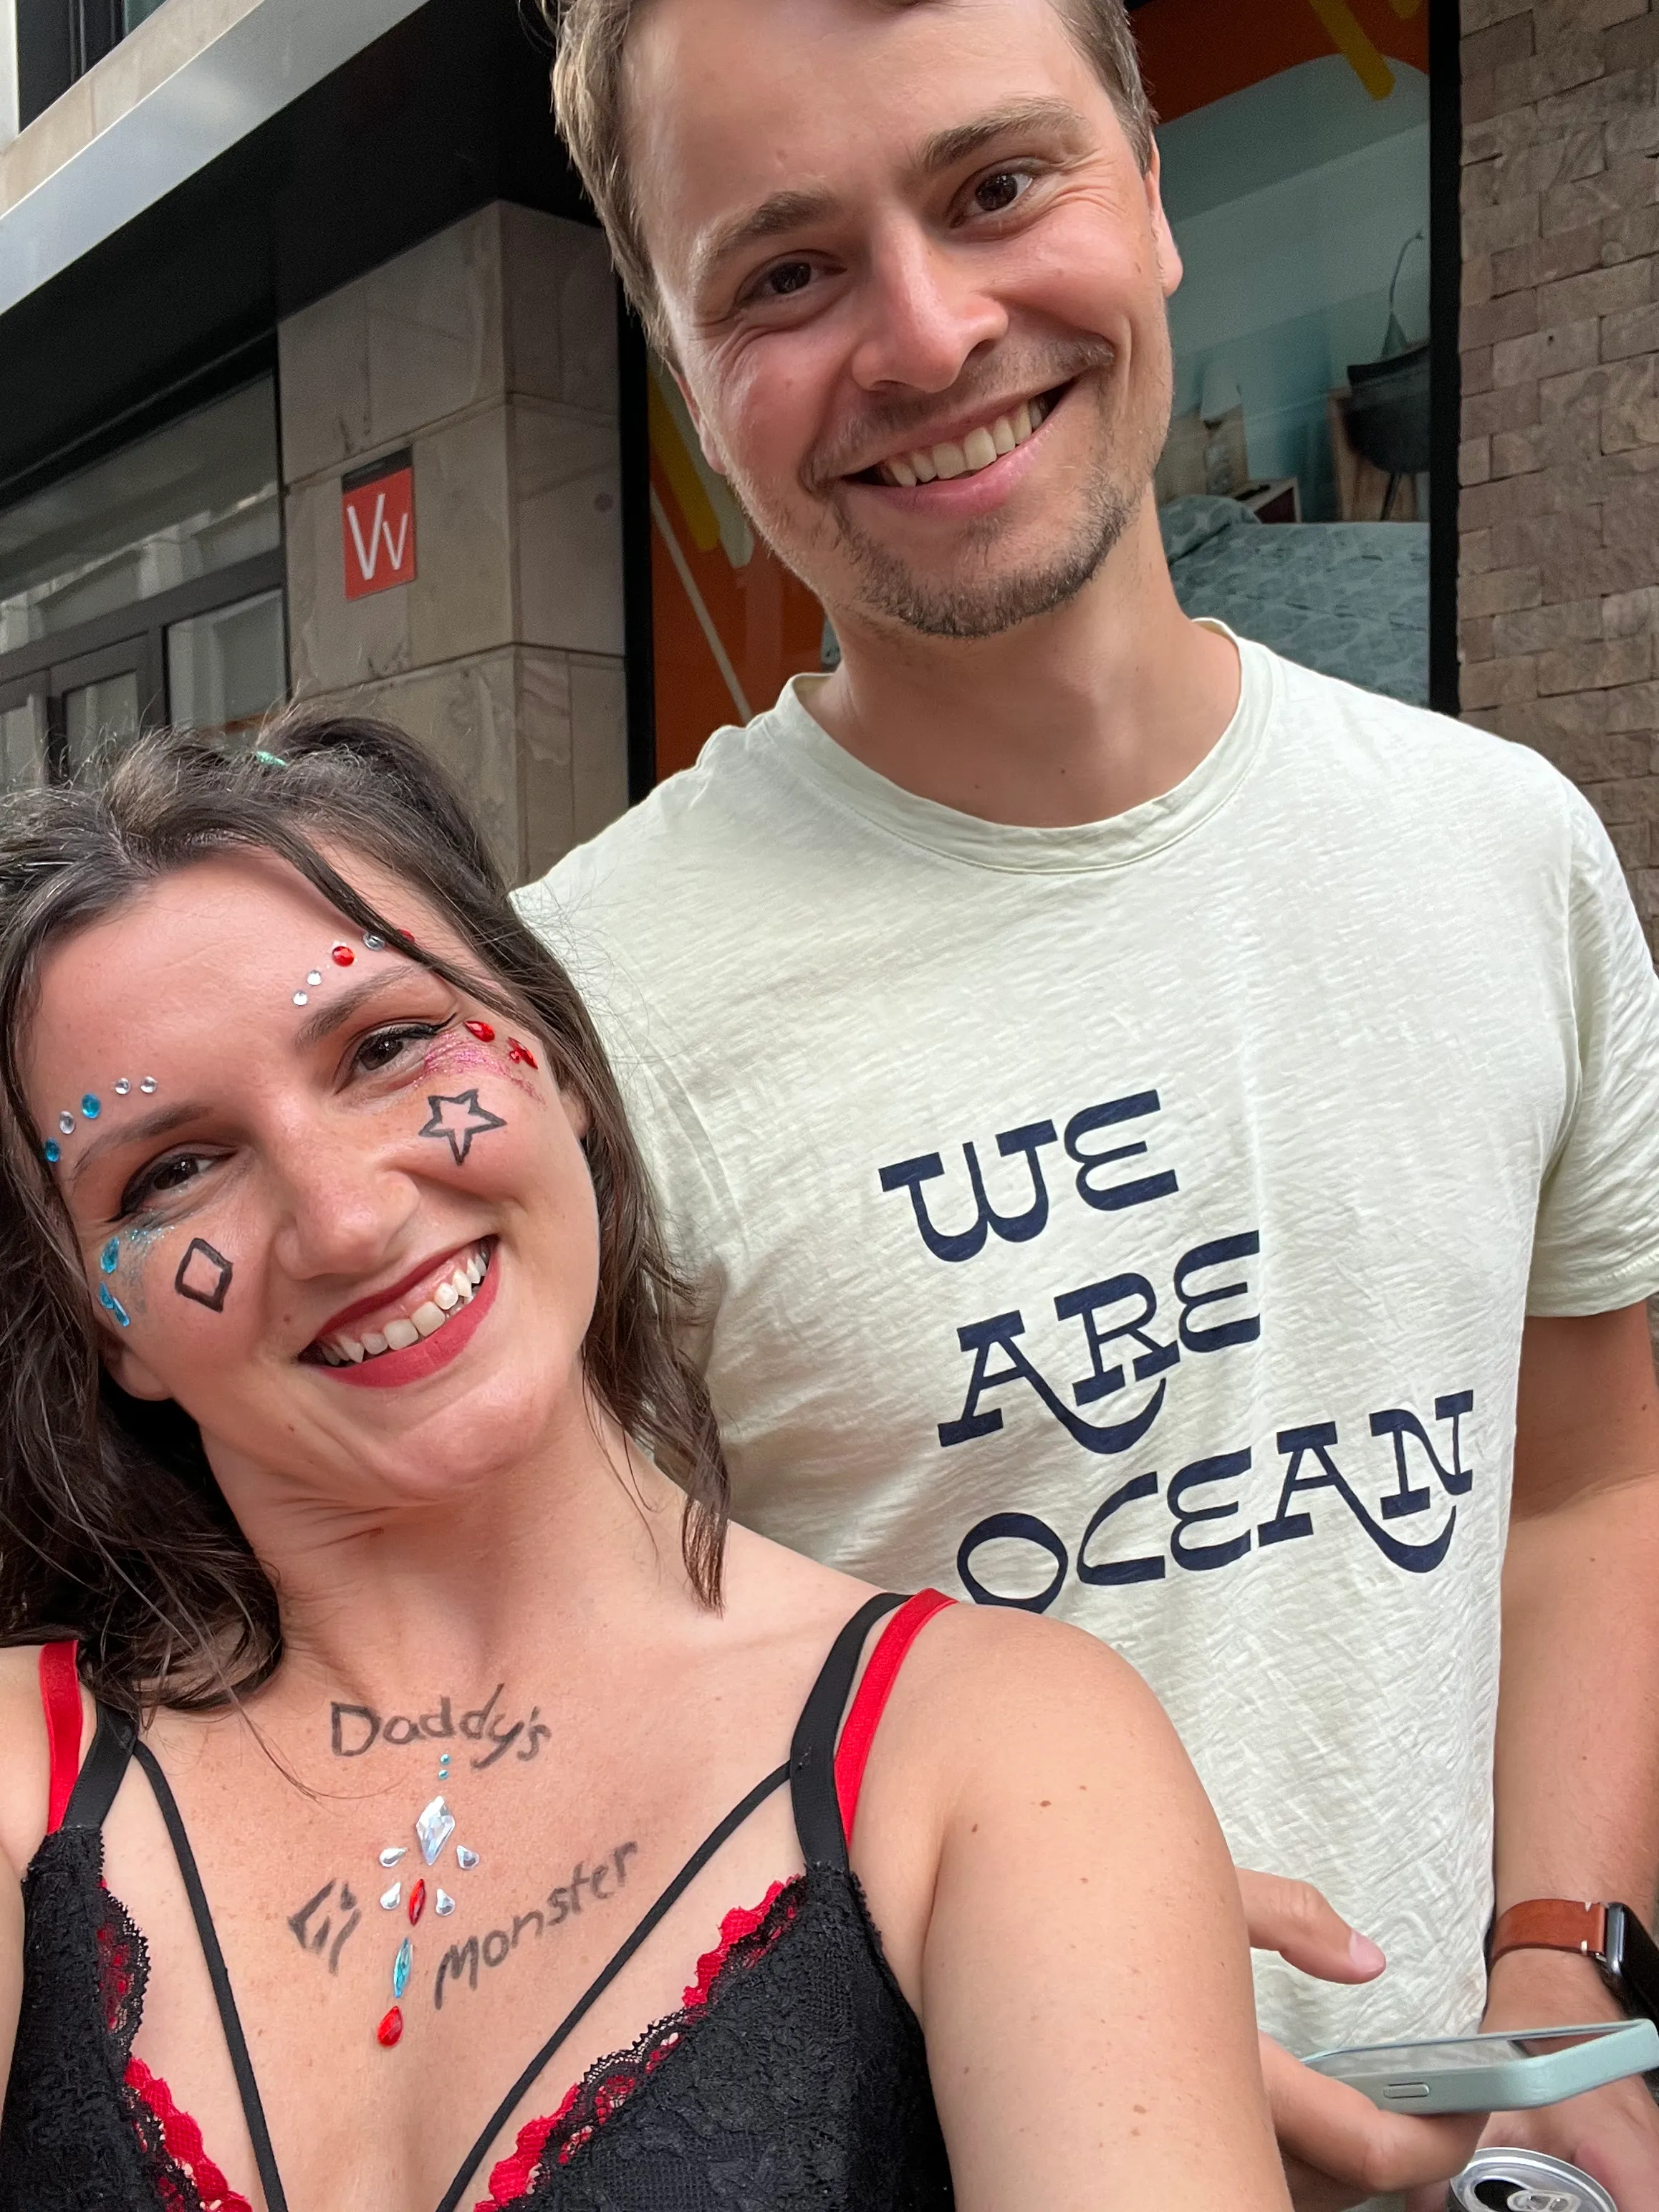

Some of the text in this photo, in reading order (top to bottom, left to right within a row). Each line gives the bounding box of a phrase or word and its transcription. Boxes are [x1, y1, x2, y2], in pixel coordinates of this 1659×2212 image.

[878, 1089, 1180, 1262] WE
[938, 1229, 1261, 1455] ARE
[956, 1389, 1474, 1615] OCEAN
[330, 1682, 552, 1770] Daddy's
